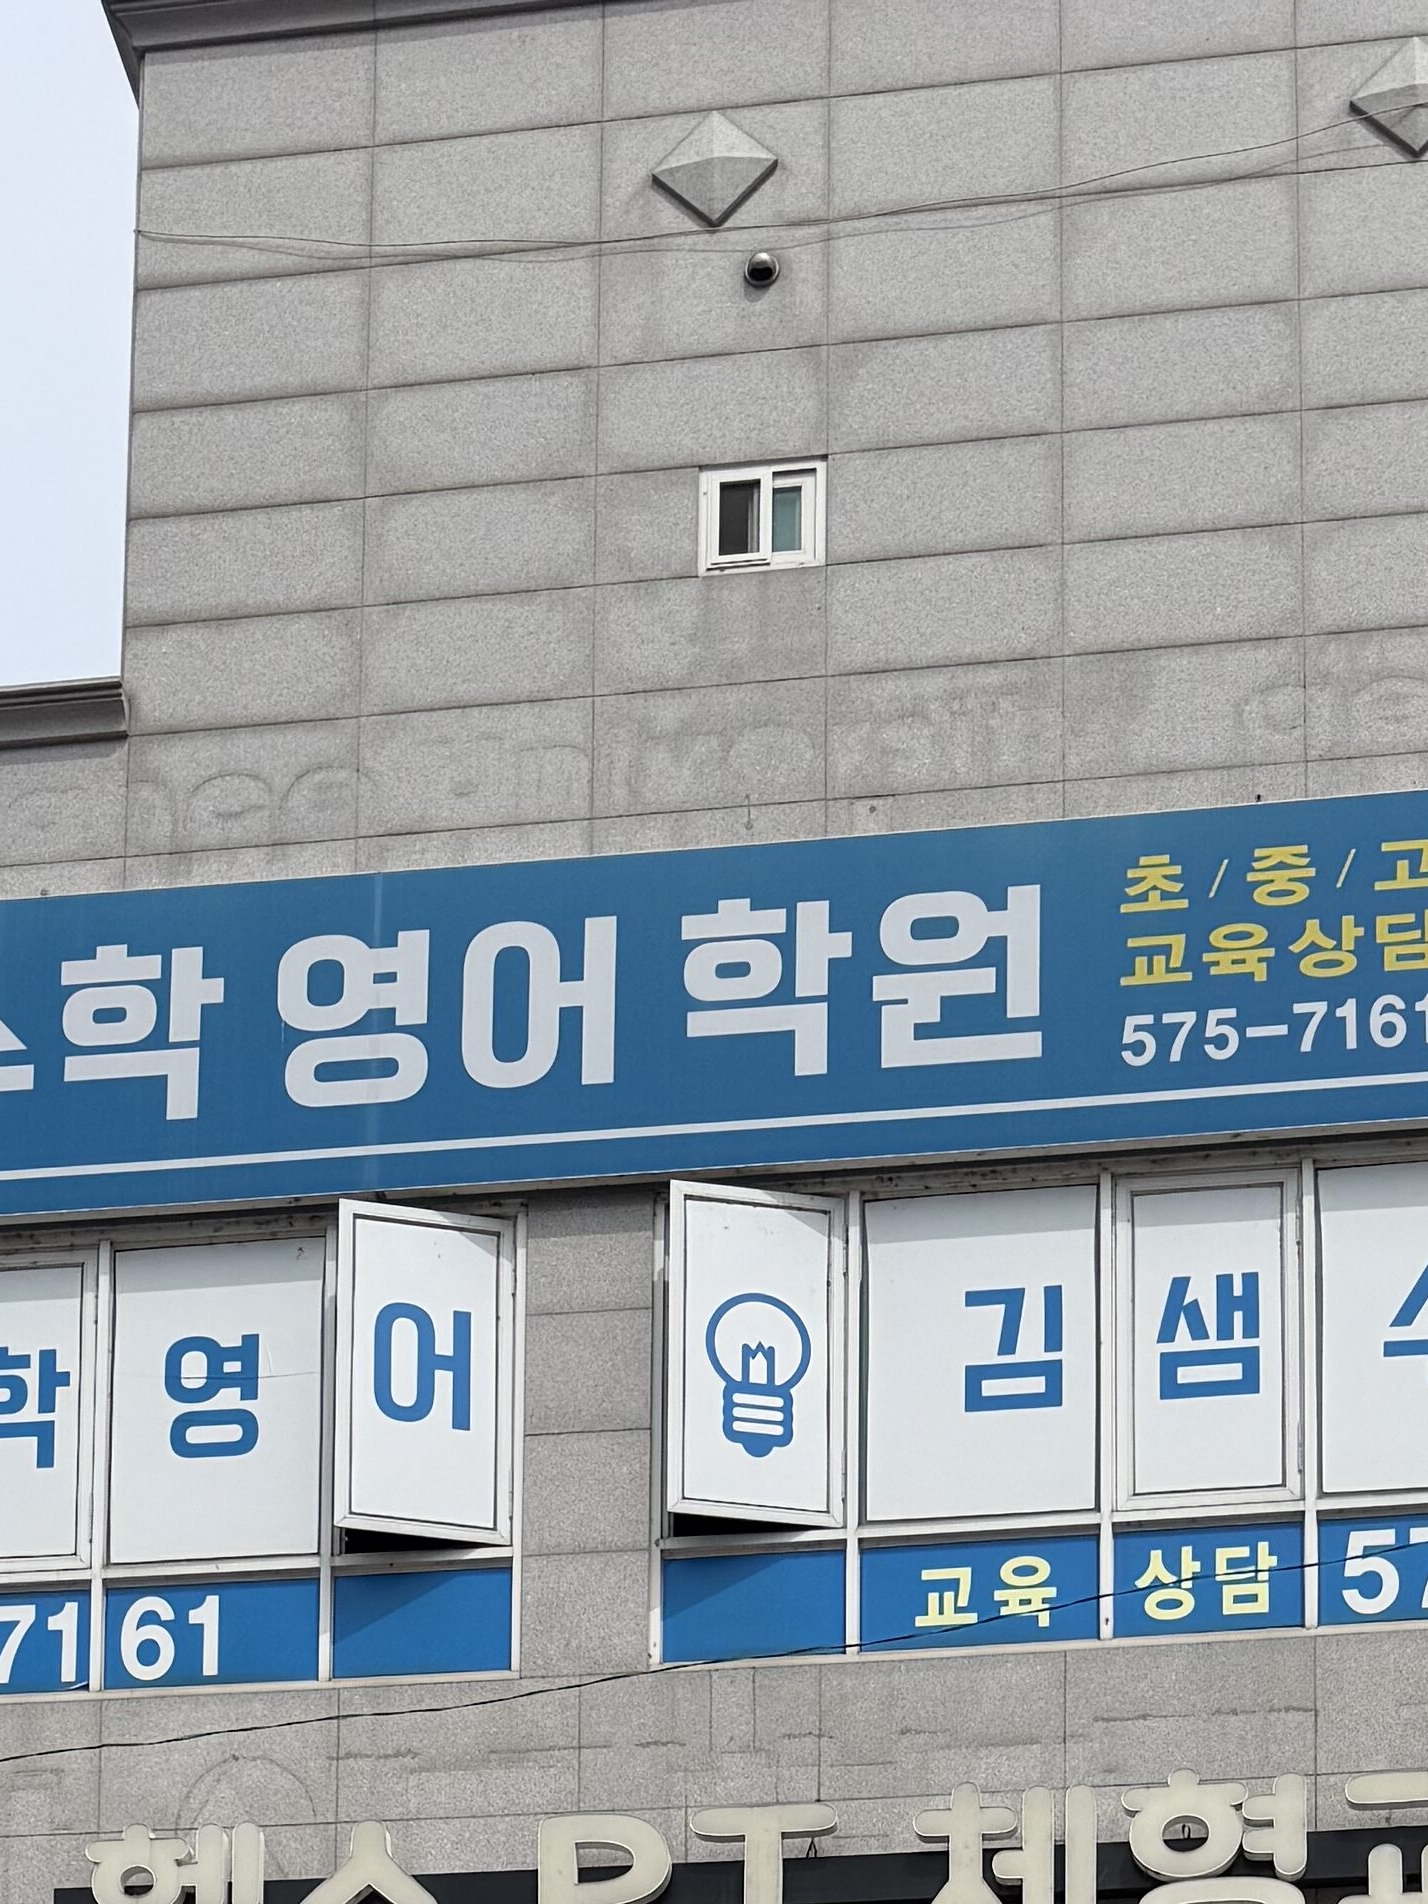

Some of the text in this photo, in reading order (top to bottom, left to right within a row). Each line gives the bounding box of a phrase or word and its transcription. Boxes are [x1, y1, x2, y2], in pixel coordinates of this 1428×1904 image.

[277, 916, 618, 1109] 영어
[680, 884, 1042, 1077] 학원
[914, 1555, 1057, 1629] 교육
[1134, 1542, 1277, 1619] 상담
